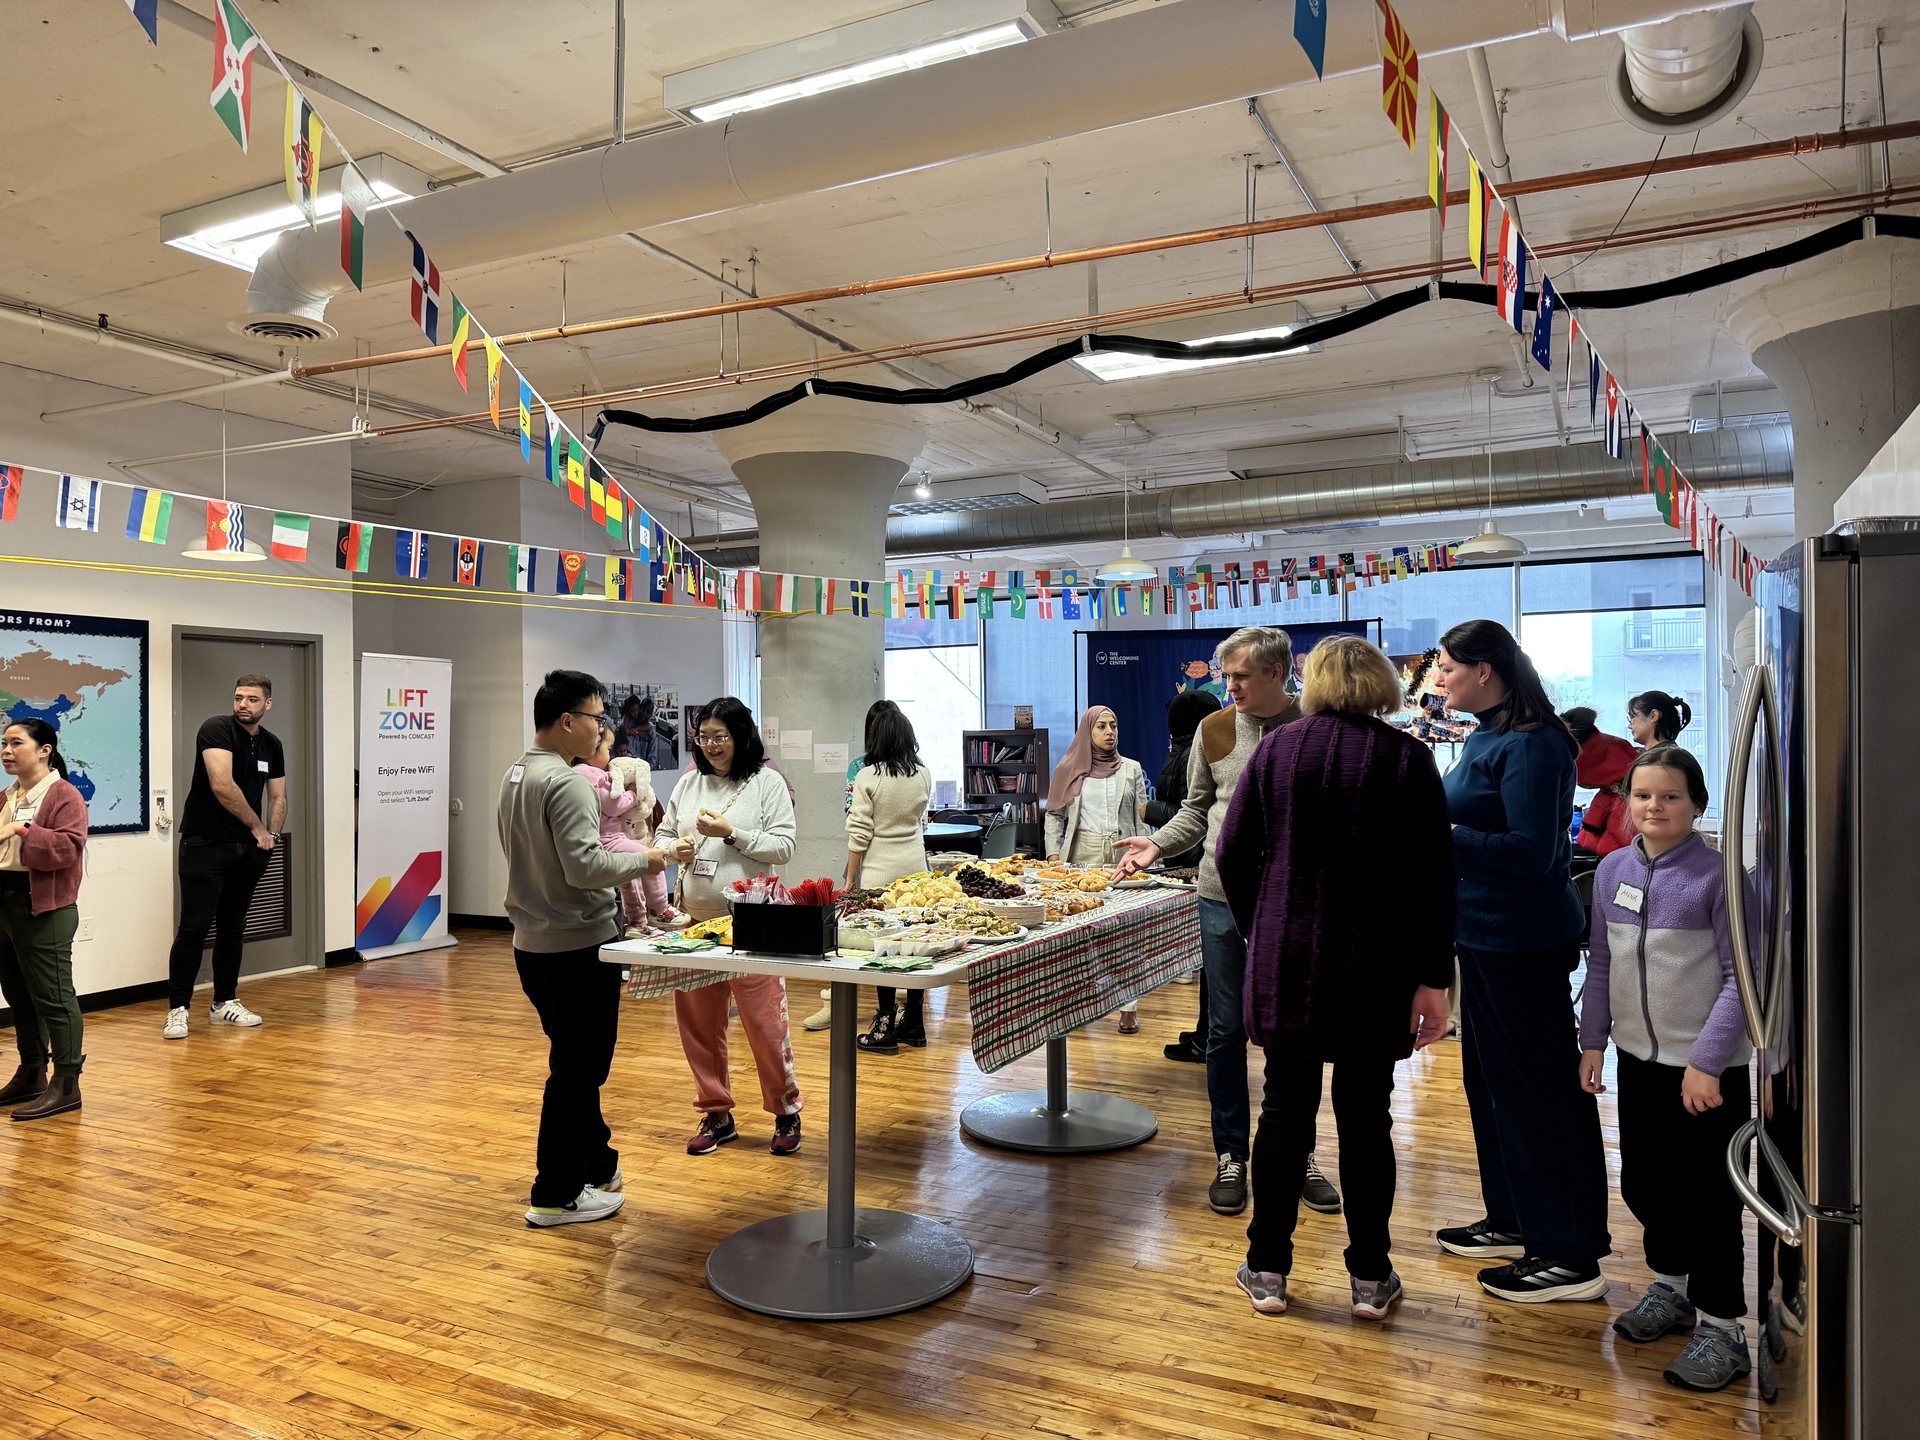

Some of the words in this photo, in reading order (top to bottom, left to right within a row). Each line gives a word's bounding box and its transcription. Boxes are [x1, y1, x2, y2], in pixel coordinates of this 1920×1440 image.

[29, 617, 71, 628] FROM?
[387, 688, 428, 707] LIFT
[379, 711, 435, 730] ZONE
[378, 766, 399, 777] Enjoy
[400, 766, 417, 775] Free
[417, 765, 435, 774] WiFi
